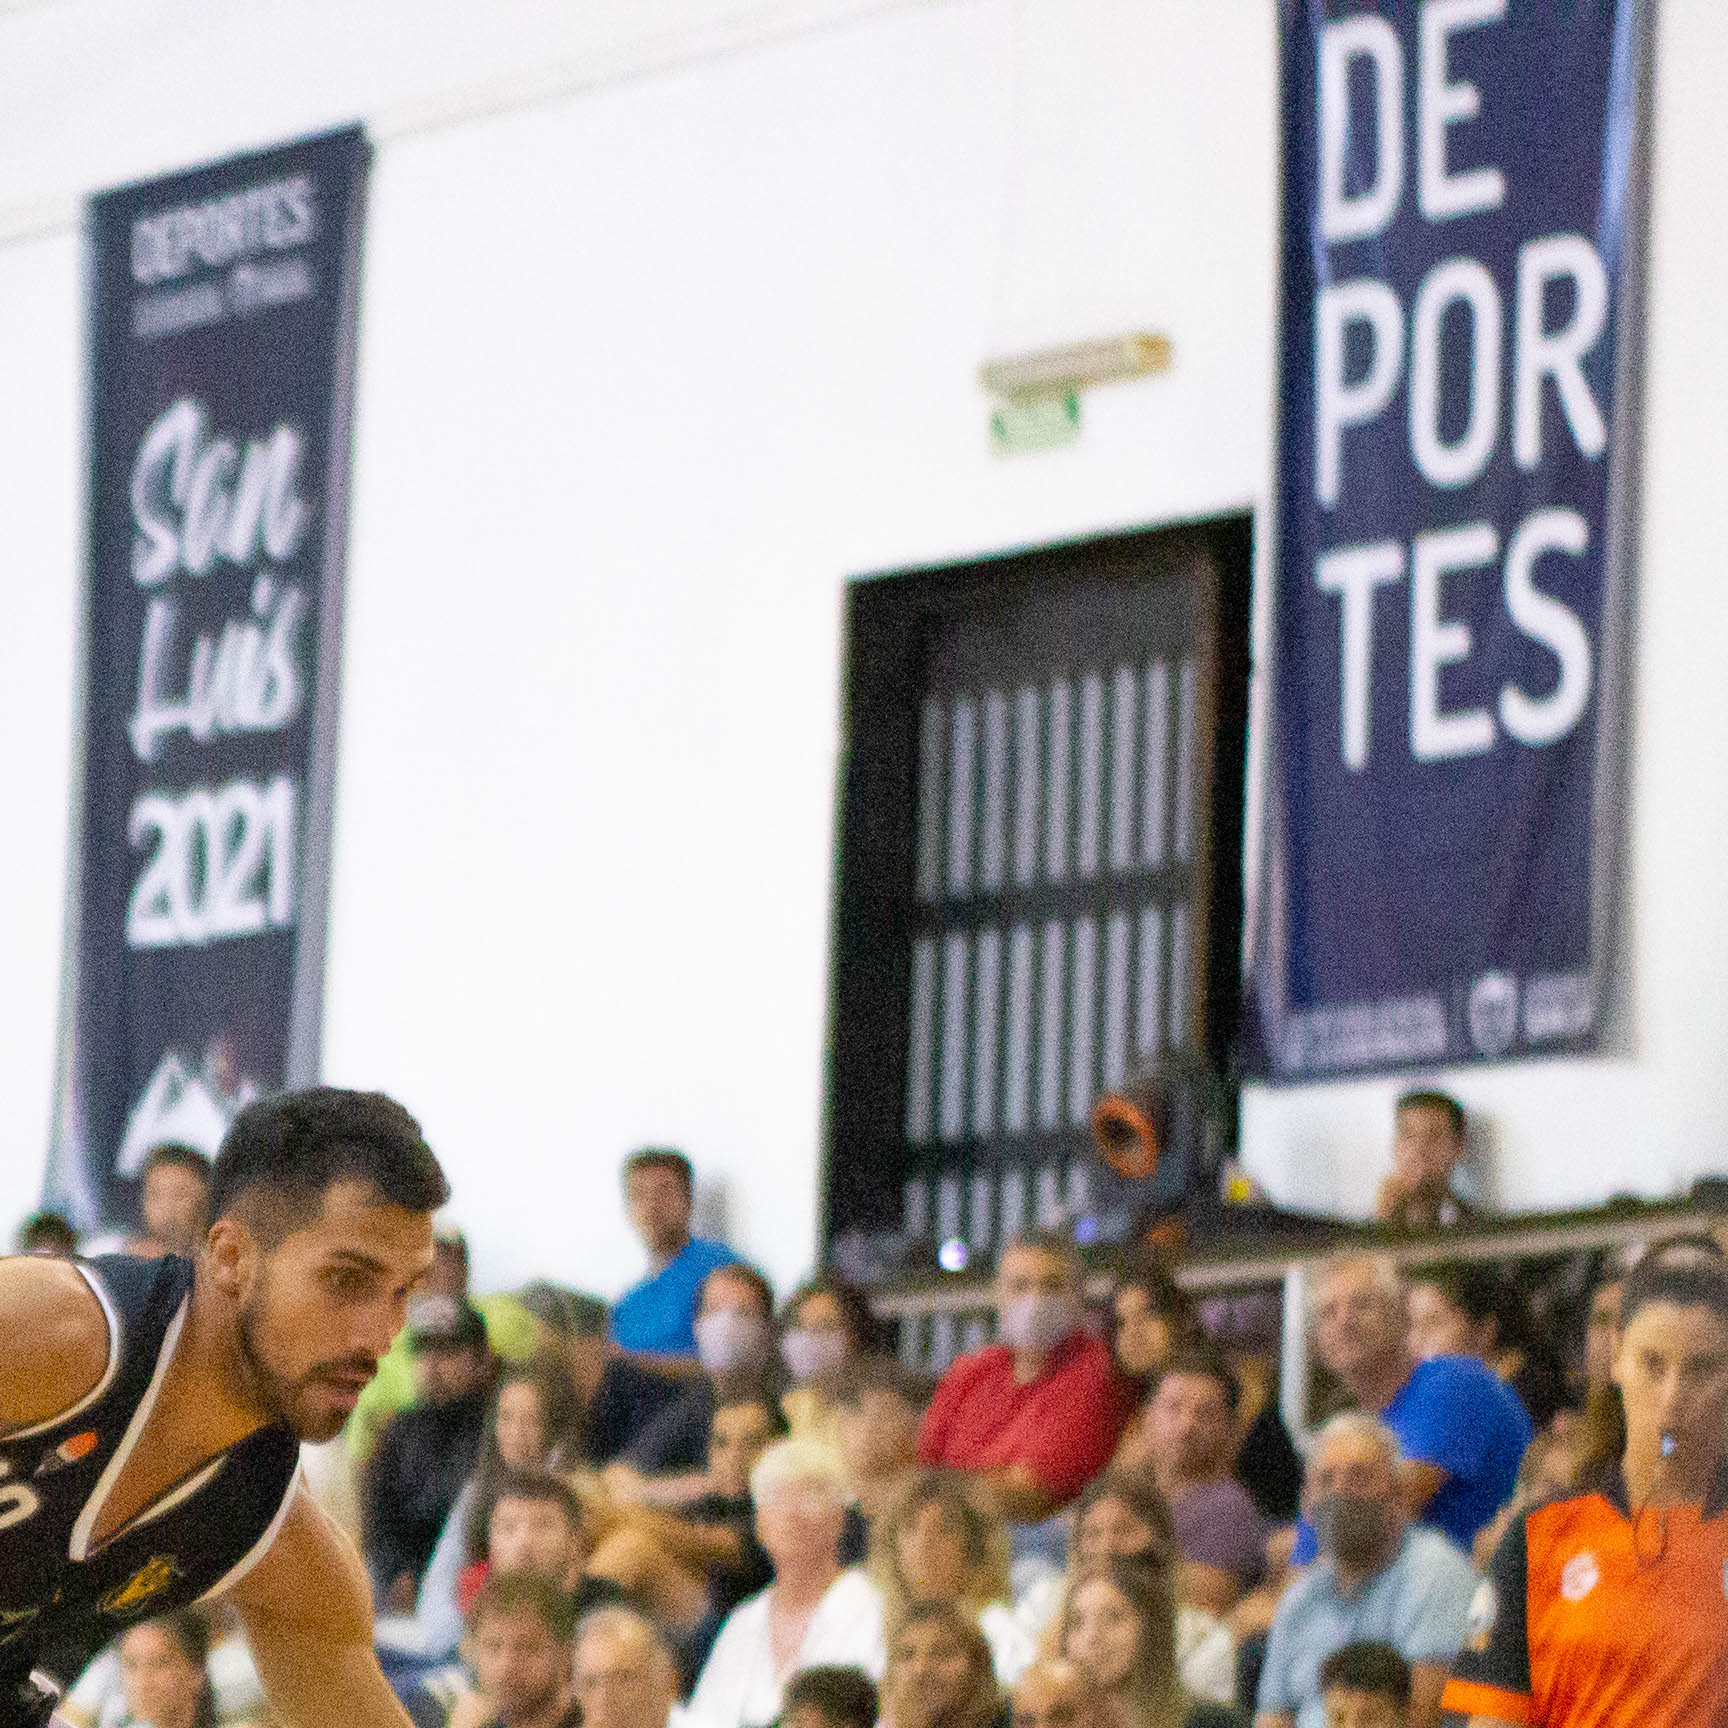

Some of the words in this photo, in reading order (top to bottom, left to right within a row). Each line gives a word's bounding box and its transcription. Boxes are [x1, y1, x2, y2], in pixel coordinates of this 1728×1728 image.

[1316, 0, 1510, 244] DE
[1313, 232, 1610, 508] POR
[131, 400, 304, 588] San
[1315, 506, 1594, 770] TES
[126, 776, 295, 950] 2021
